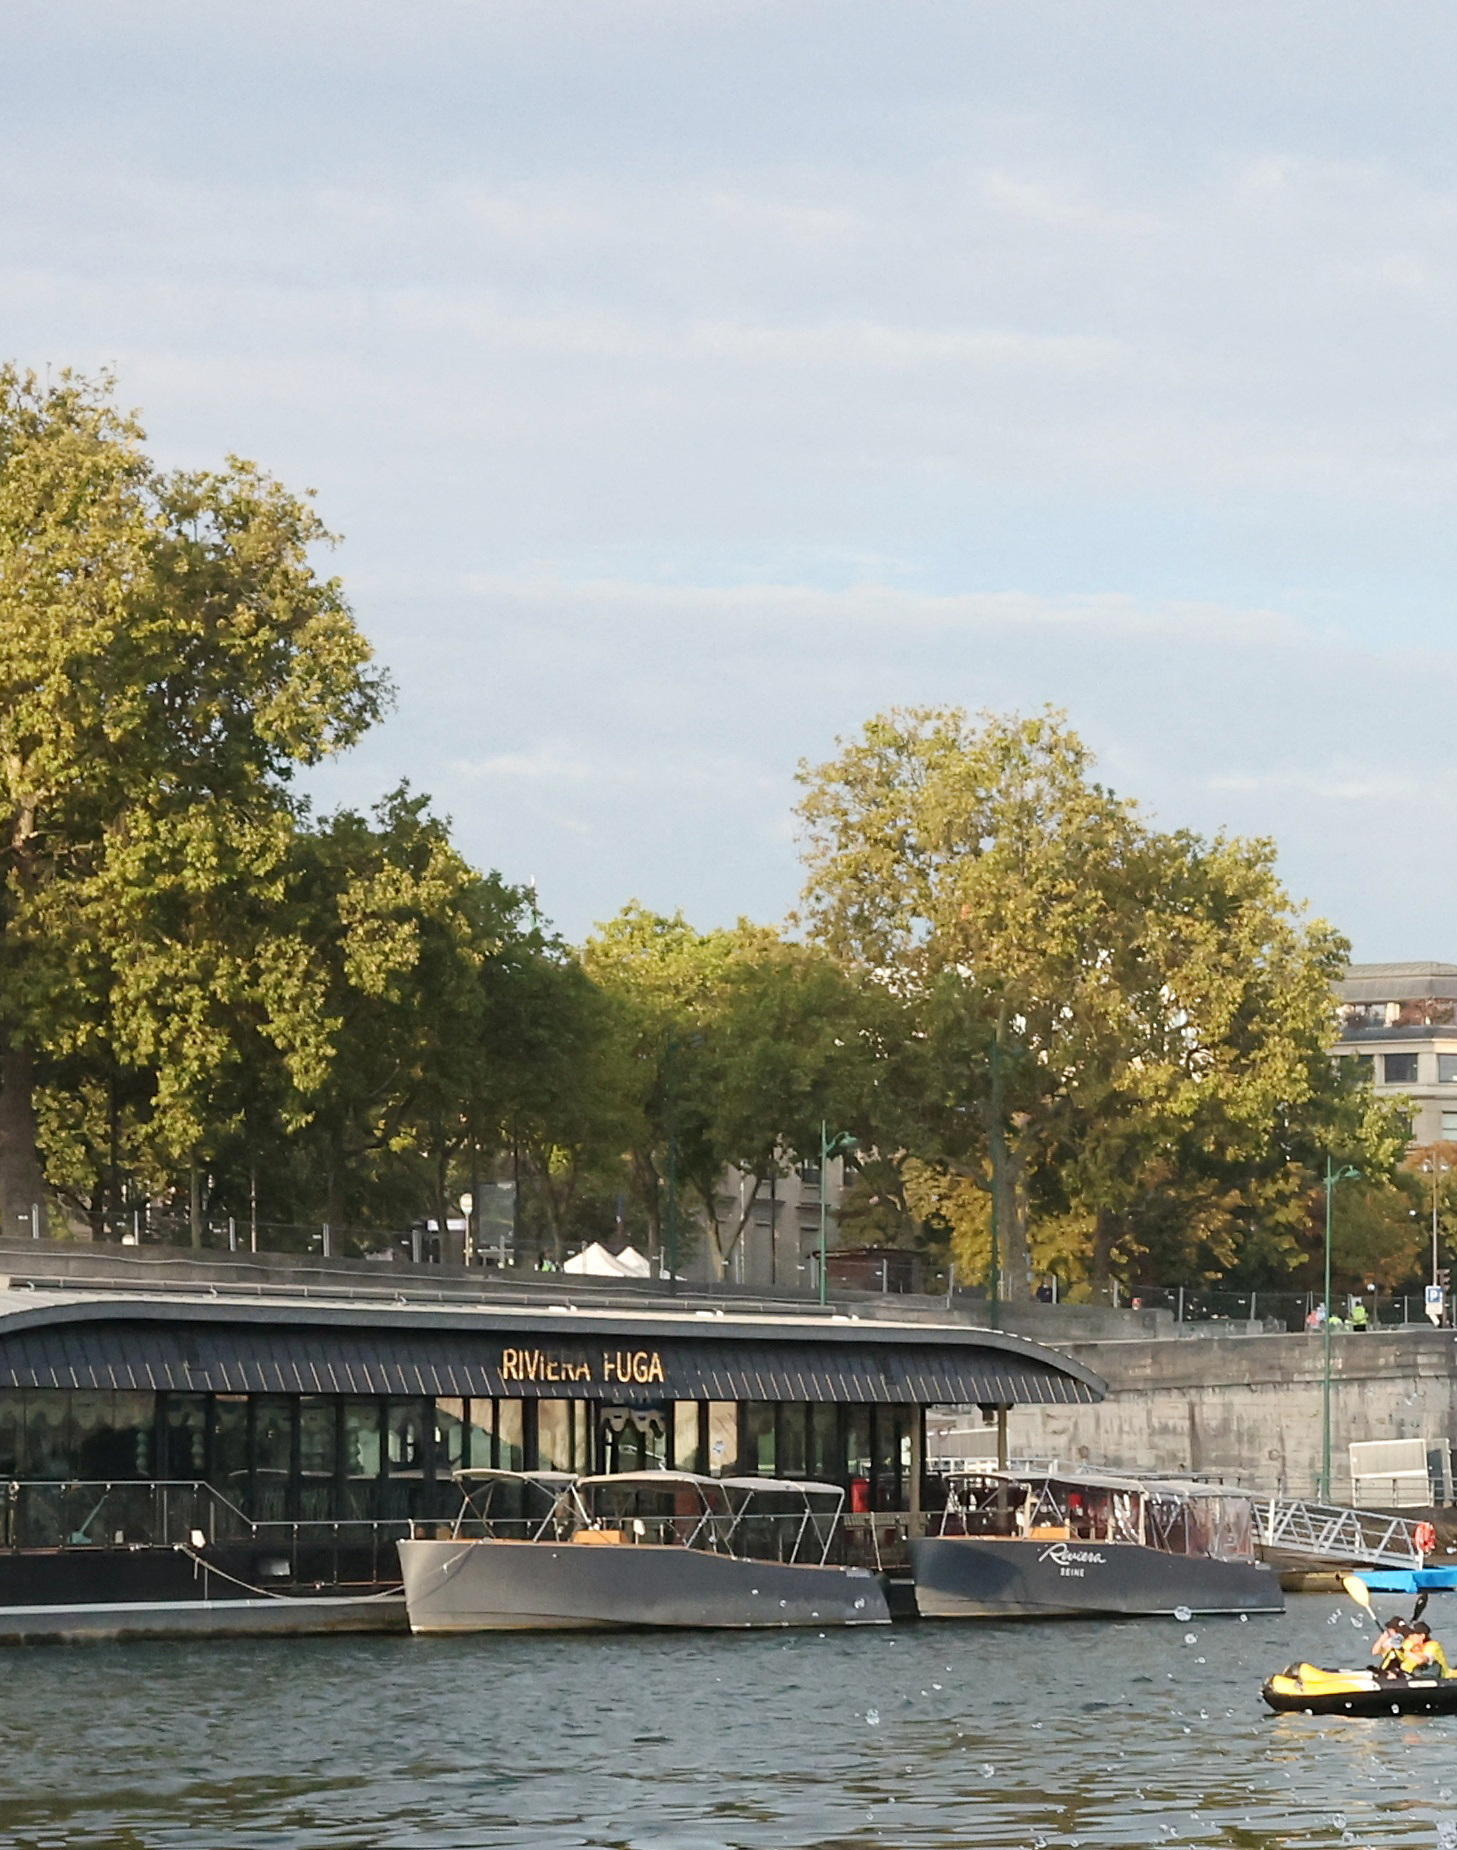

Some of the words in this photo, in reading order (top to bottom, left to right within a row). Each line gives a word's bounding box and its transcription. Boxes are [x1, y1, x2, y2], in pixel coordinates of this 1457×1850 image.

[603, 1351, 665, 1384] FUGA
[1038, 1542, 1107, 1566] Riviera
[1060, 1567, 1085, 1578] SEINE
